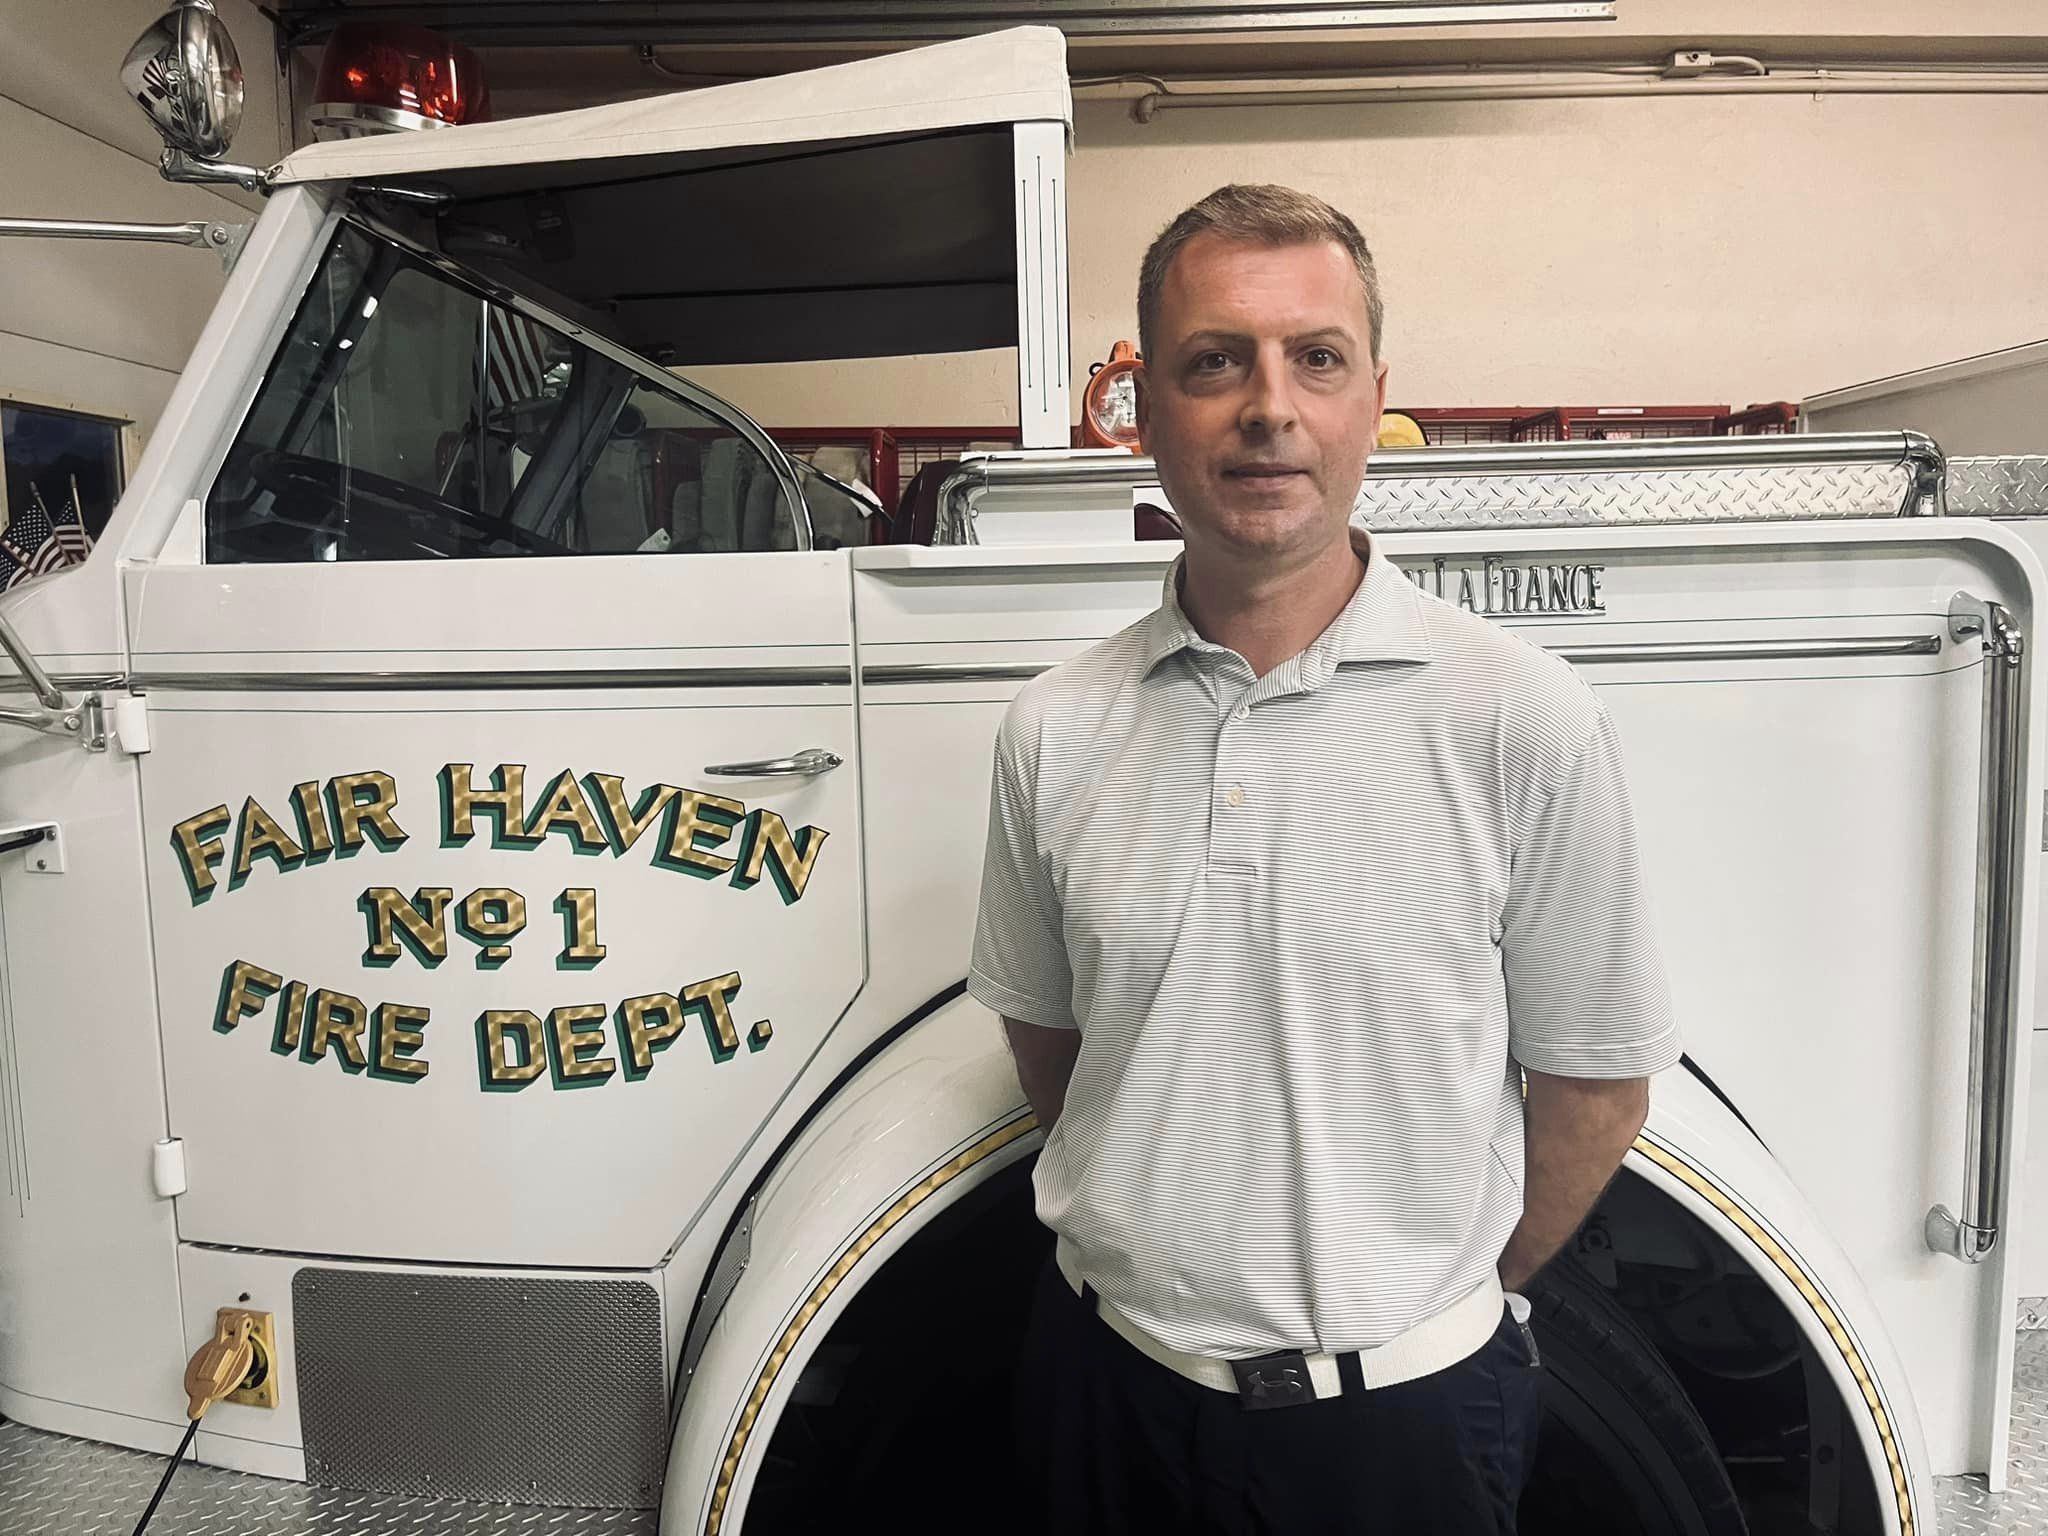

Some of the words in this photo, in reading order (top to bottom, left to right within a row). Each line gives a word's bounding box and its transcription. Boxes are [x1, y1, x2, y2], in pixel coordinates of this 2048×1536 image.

[170, 770, 410, 908] FAIR
[436, 763, 829, 906] HAVEN
[553, 888, 606, 971] 1
[212, 959, 430, 1084] FIRE
[474, 971, 774, 1093] DEPT.
